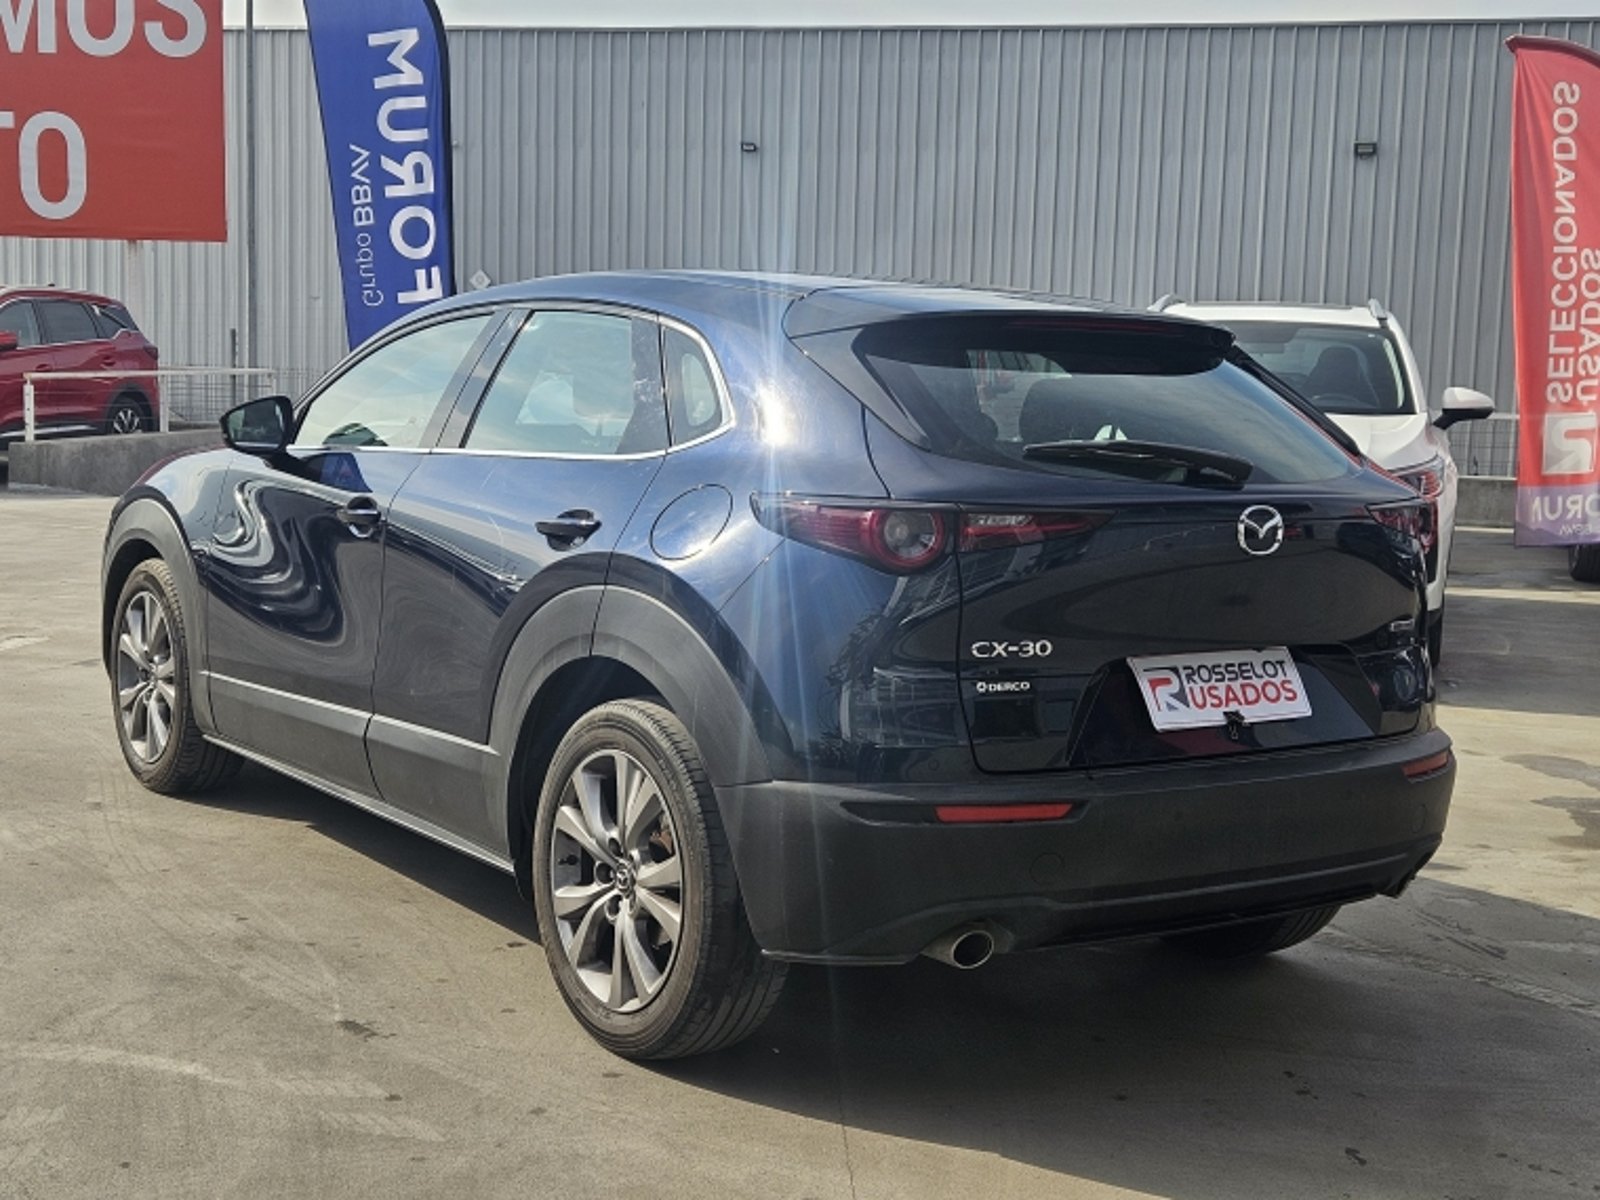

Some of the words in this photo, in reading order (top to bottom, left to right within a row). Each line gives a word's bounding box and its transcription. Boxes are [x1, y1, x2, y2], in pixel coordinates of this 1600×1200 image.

[0, 110, 87, 219] O
[971, 640, 1053, 658] CX-30
[1183, 660, 1286, 685] ROSSELOT
[1188, 679, 1298, 709] USADOS
